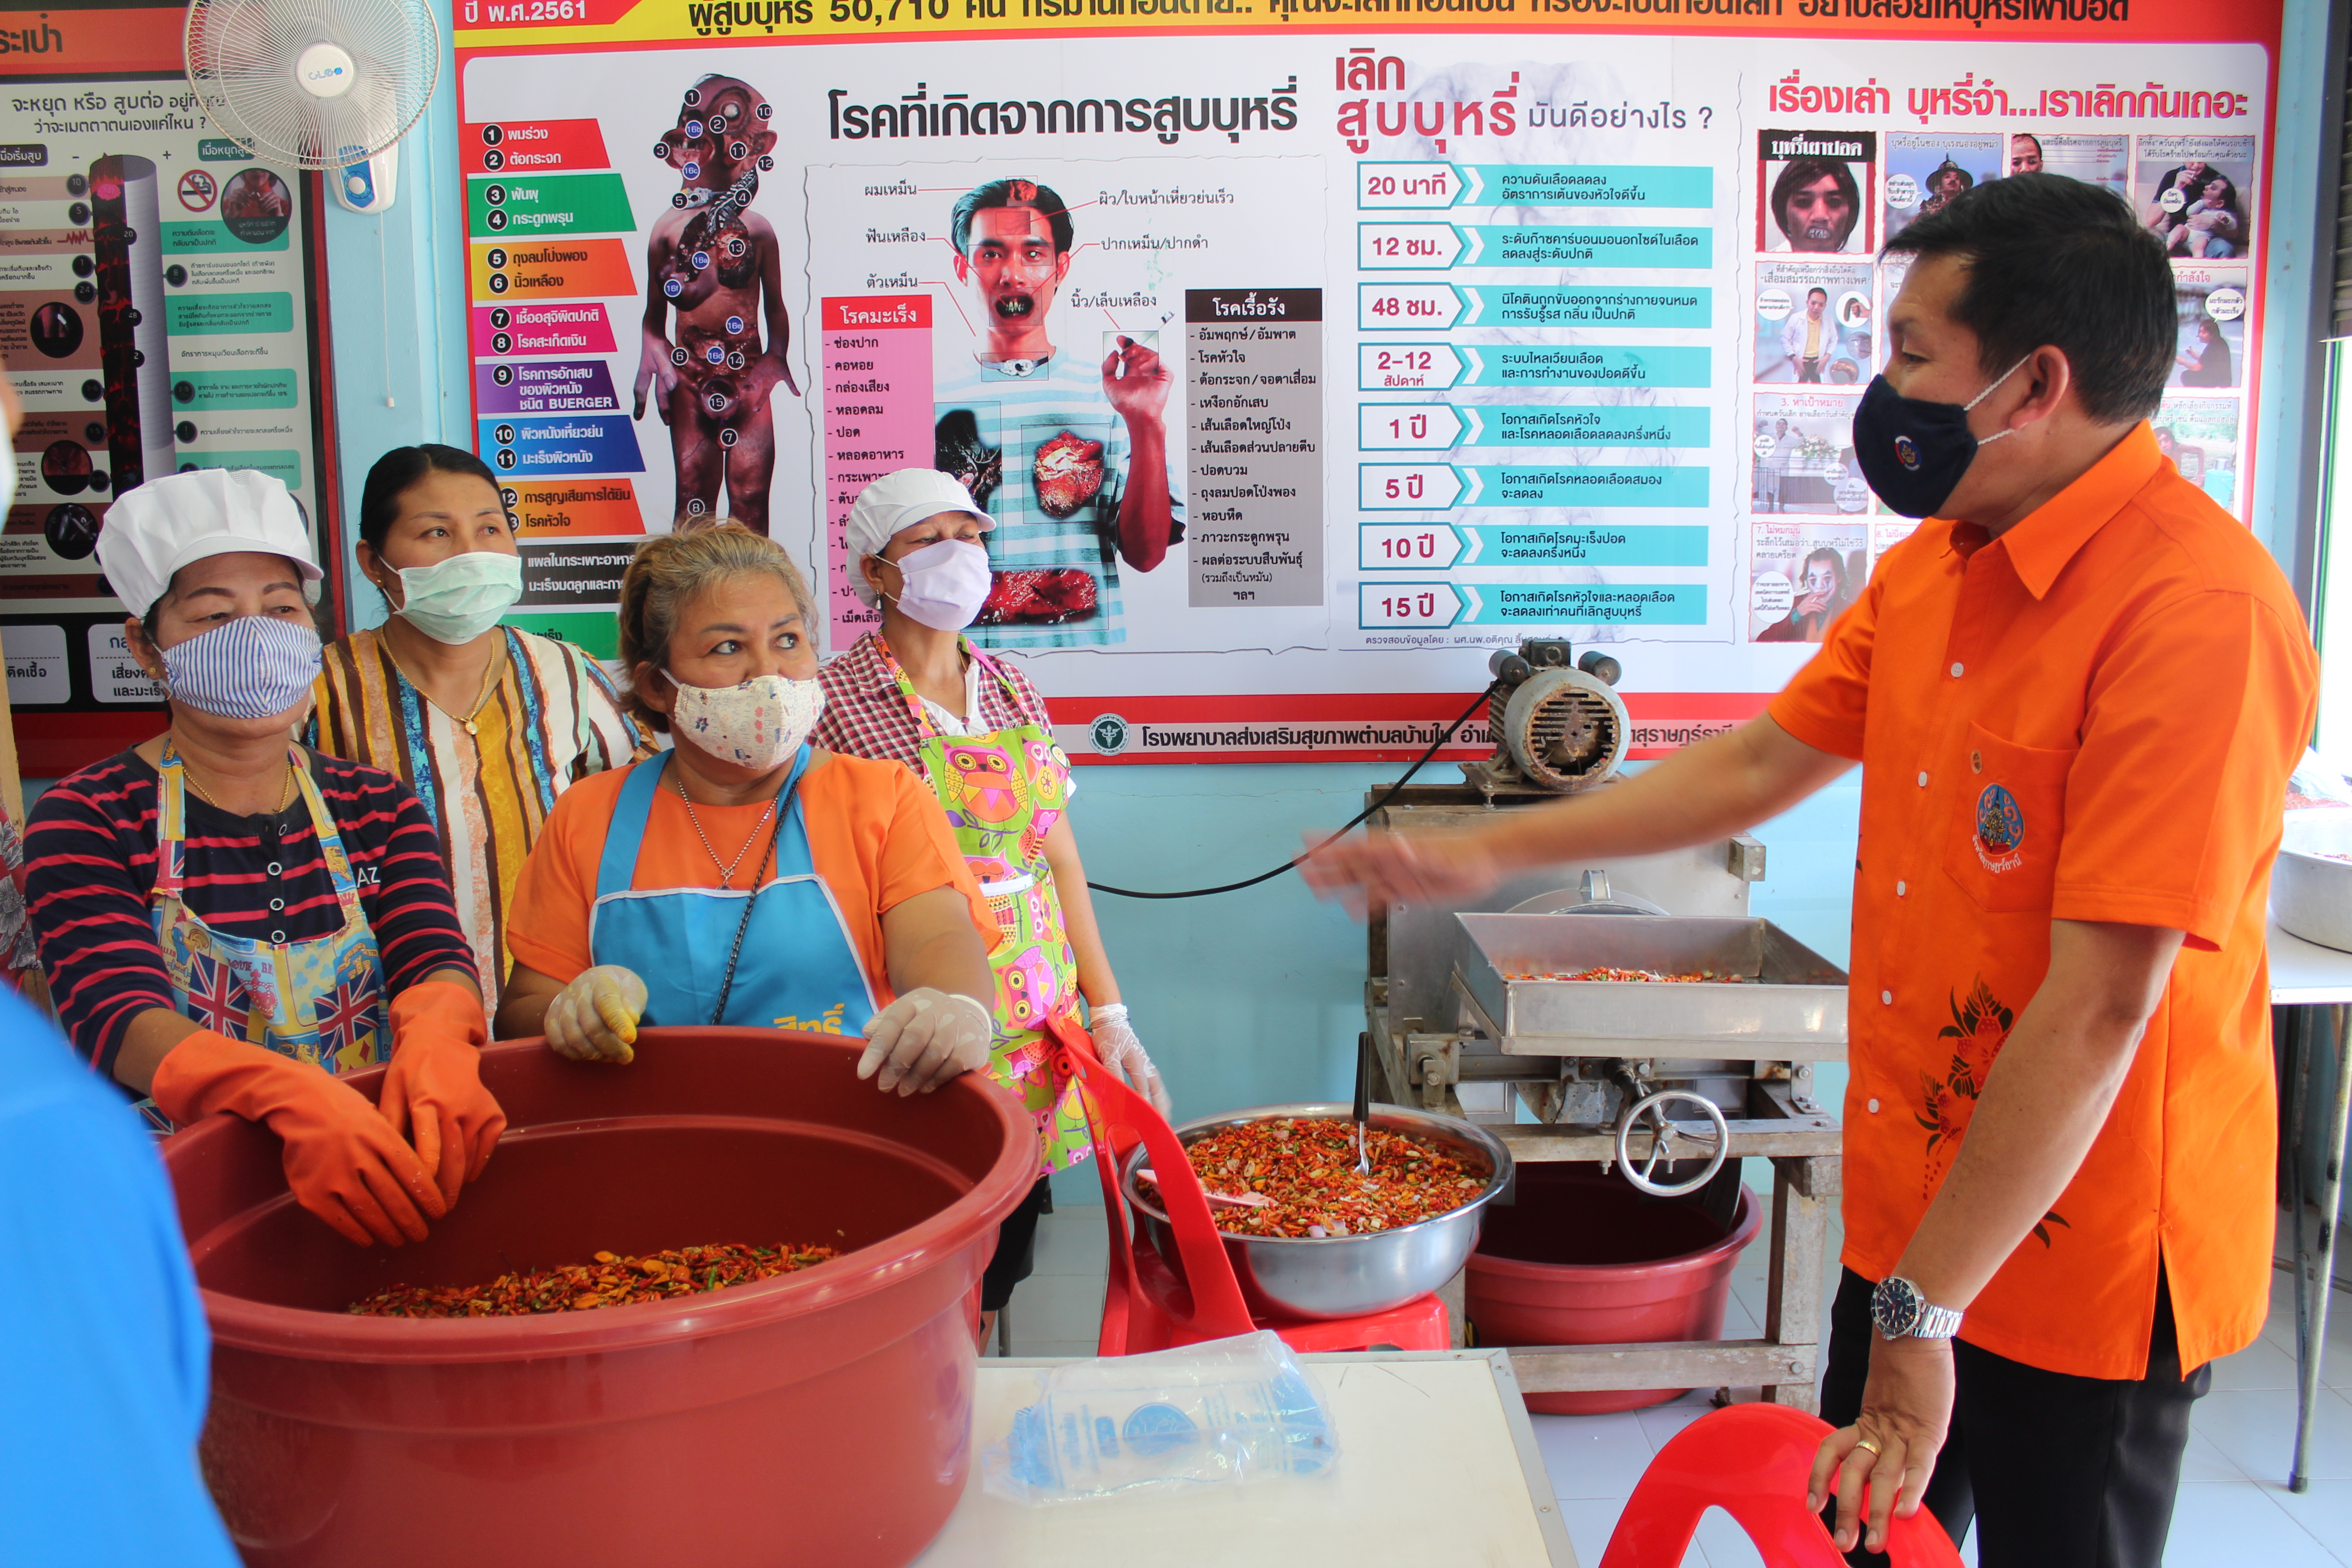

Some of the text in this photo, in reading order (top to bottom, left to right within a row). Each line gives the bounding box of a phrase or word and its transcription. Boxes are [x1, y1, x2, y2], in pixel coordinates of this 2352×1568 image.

[1336, 48, 1405, 91] เลิก
[1768, 69, 1890, 113] เรื่องเล่า
[12, 91, 164, 117] จะหยุด หรือ สูบต่อ
[828, 75, 1298, 144] โรคที่เกิดจากการสูบบุหรี่
[759, 108, 771, 116] 10
[1337, 71, 1713, 154] สูบบุหรี่ มันดีอย่างไร ?
[34, 113, 206, 133] ว่าจะเมตตาตนเองแค่ไหน ?
[489, 127, 548, 140] 1 ผมร่วง
[1771, 133, 1862, 160] บุหรี่เผาปอด
[490, 152, 561, 165] 2 ต้อกระจก
[760, 159, 772, 168] 12
[1367, 173, 1446, 196] 20 นาที
[1502, 173, 1607, 185] ความดันเลือดลดลง
[491, 188, 539, 203] 3 ฟันผุ
[864, 180, 917, 196] ผมเหม็น
[1502, 185, 1645, 200] อัตราการเต้นของหัวใจดีขึ้น
[1099, 187, 1234, 205] ผิว/ใบหน้าเหี่ยวย่นเร็ว
[492, 211, 573, 227] 4 กระดูกพรุน
[866, 228, 926, 243] ฟันเหลือง
[1101, 234, 1209, 250] ปากเหม็น/ปากดำ
[1502, 232, 1698, 246] ระดับก๊าซคาร์บอนมอนอกไซด์ในเลือด
[1372, 238, 1442, 255] 12 ชม.
[492, 247, 588, 267] 5 ถุงลมโป่งพอง
[1502, 247, 1593, 262] ลดลงสู่ระดับปกติ
[494, 272, 564, 289] 6 นิ้วเหลือง
[867, 272, 918, 289] ตัวเหม็น
[1071, 291, 1157, 308] นิ้ว/เล็บเหลือง
[1212, 292, 1286, 316] โรคเรื้อรัง
[1372, 298, 1442, 316] 48 ชม.
[1502, 293, 1697, 309] นิโคตินถูกขับออกจากร่างกายจนหมด
[495, 309, 599, 326] 7 เชื้ออสุจิผิดปกติ
[839, 303, 916, 324] โรคมะเร็ง
[1502, 305, 1635, 322] การรับรู้รส กลิ่น เป็นปกติ
[497, 334, 587, 348] 8 โรคสะเก็ดเงิน
[834, 337, 878, 348] ช่องปาก
[709, 352, 722, 360] 16d
[1198, 350, 1245, 363] โรคหัวใจ
[1502, 352, 1603, 363] ระบบไหลเวียนเลือด
[835, 361, 873, 370] คอหอย
[1502, 364, 1646, 379] และการทำงานของปอดดีขึ้น
[498, 366, 593, 381] 9 โรคการอักเสบ
[1384, 373, 1424, 387] สัปดาห์
[519, 383, 583, 396] ของผิวหนัง
[835, 379, 890, 392] กล่องเสียง
[519, 397, 612, 410] ชนิด BUERGER
[710, 398, 723, 407] 15
[1200, 395, 1268, 407] เหงือกอักเสบ
[836, 405, 883, 415] หลอดลม
[1200, 417, 1291, 434] เส้นเลือดใหญ่โป่ง
[1390, 414, 1426, 439] 1 ปี
[1501, 412, 1600, 426] โอกาสเกิดโรคหัวใจ
[496, 423, 603, 441] 10 ผิวหนังเหี่ยวย่น
[836, 426, 860, 437] ปอด
[1501, 425, 1671, 441] และโรคหลอดเลือดลดลงครึ่งหนึ่ง
[1200, 439, 1315, 453] เส้นเลือดส่วนปลายตีบ
[499, 449, 593, 465] 11 มะเร็งผิวหนัง
[837, 451, 904, 460] หลอดอาหาร
[1200, 464, 1248, 476] ปอดบวม
[1385, 474, 1423, 498] 5 ปี
[1501, 472, 1661, 486] โอกาสเกิดโรคหลอดเลือดสมอง
[524, 487, 630, 505] การสูญเสียการได้ยิน
[1201, 484, 1296, 502] ถุงลมปอดโป่งพอง
[1501, 488, 1543, 499] จะลดลง
[526, 513, 571, 527] โรคหัวใจ
[1202, 507, 1243, 521] หอบหืด
[1201, 533, 1289, 546] ภาวะกระดูกพรุน
[1501, 531, 1625, 545] โอกาสเกิดโรคมะเร็งปอด
[1382, 534, 1435, 559] 10 ปี
[1501, 544, 1586, 559] จะลดลงครึ่งหนึ่ง
[1202, 551, 1303, 568] ผลต่อระบบสืบพันธุ์
[1202, 571, 1272, 583] (รวมถึงเป็นหมัน)
[1233, 591, 1255, 601] ฯลฯ
[1501, 591, 1674, 604] โอกาสเกิดโรคหัวใจและหลอดเลือด
[1382, 593, 1434, 617] 15 ปี
[1501, 603, 1642, 619] จะลดลงเท่าคนที่เลิกสูบบุหรี่
